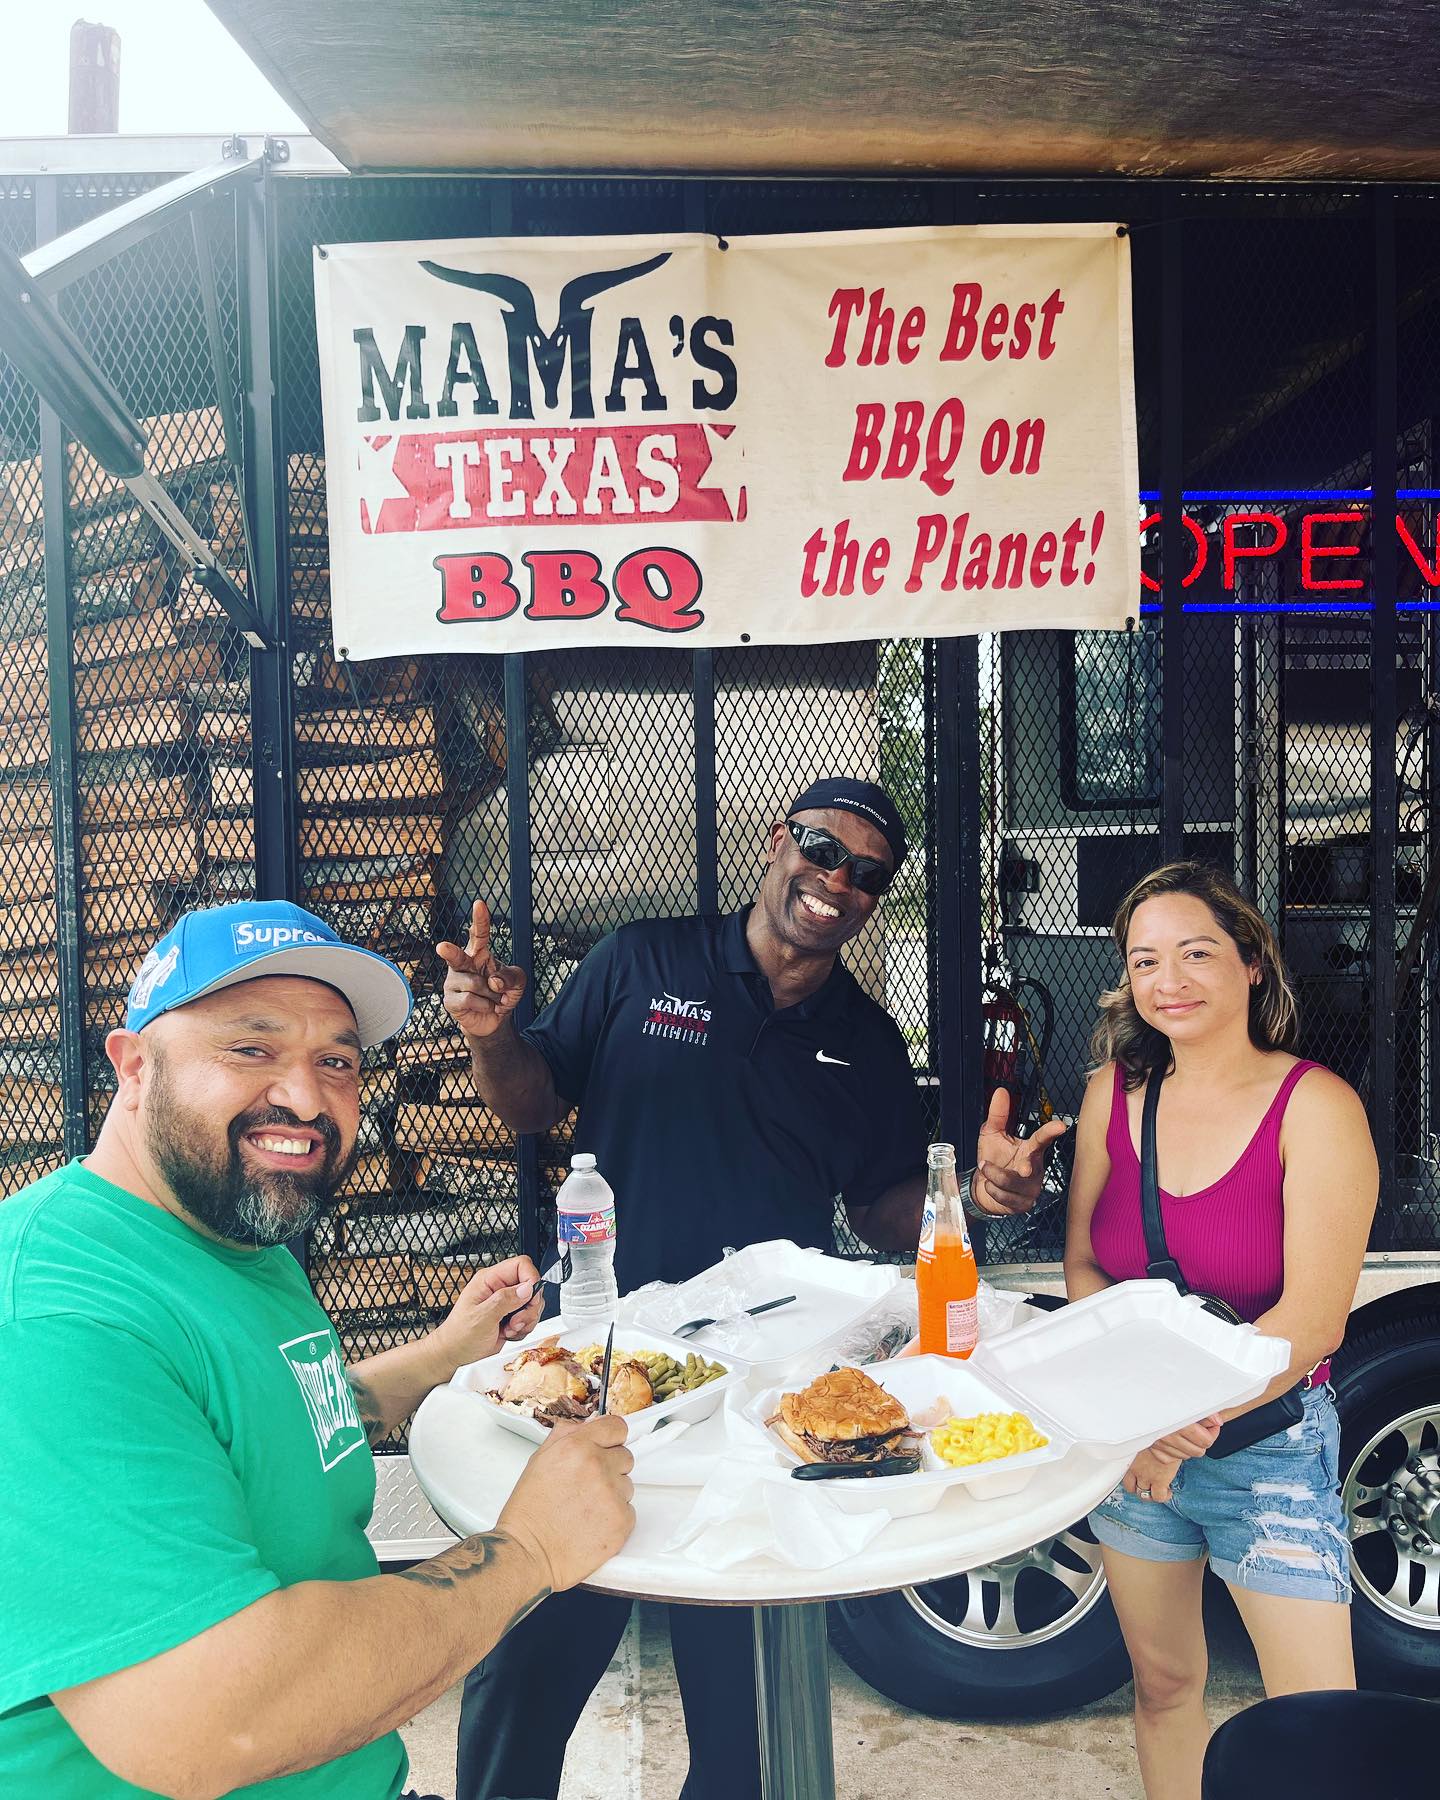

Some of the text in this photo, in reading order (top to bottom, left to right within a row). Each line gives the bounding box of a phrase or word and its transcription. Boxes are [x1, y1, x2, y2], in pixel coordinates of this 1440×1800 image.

[353, 307, 737, 422] MAMA'S
[824, 282, 1065, 368] The Best
[434, 434, 681, 519] TEXAS
[842, 397, 1046, 497] BBQ on
[433, 546, 705, 633] BBQ
[800, 510, 1105, 598] the Planet!
[833, 797, 888, 826] UNDER ARMOUR
[236, 923, 327, 947] Supre
[649, 997, 712, 1022] MAMA'S
